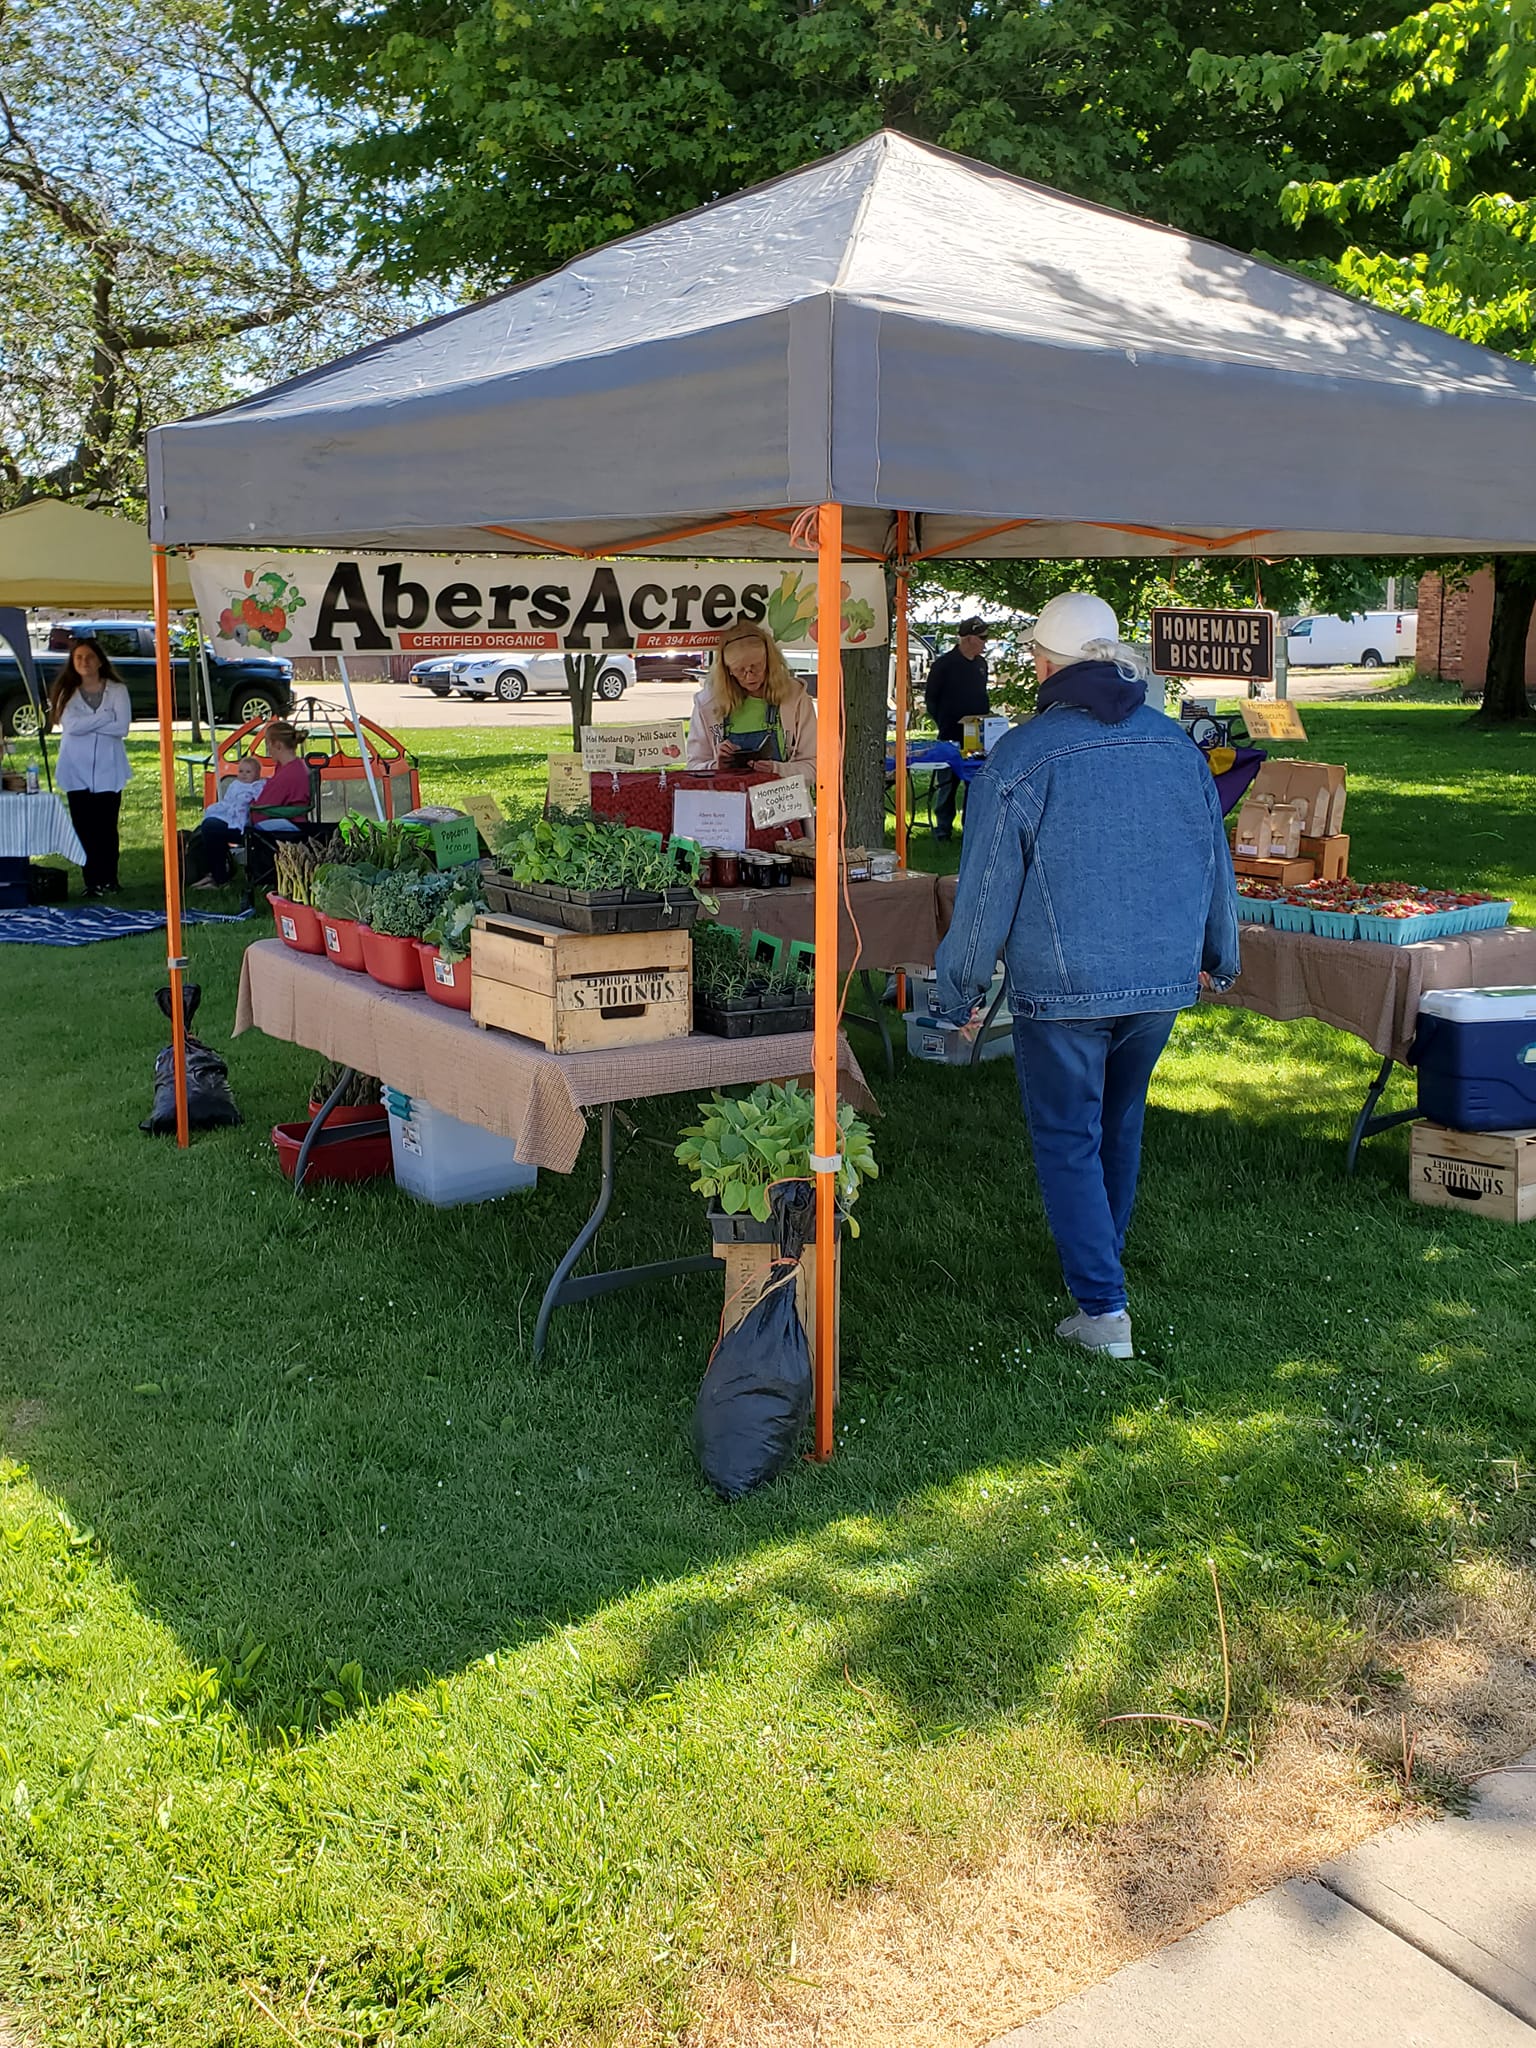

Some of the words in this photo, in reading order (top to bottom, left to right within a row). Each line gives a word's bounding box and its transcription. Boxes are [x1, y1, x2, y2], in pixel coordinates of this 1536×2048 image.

[1162, 617, 1261, 645] HOMEMADE
[413, 635, 482, 646] CERTIFIED
[485, 635, 545, 646] ORGANIC
[664, 635, 685, 646] 394
[1170, 644, 1253, 673] BISCUITS
[598, 734, 624, 743] Mustard
[624, 735, 635, 744] Dip
[653, 731, 677, 741] Sauce
[757, 782, 799, 799] Homemade
[441, 827, 469, 842] Popcorn
